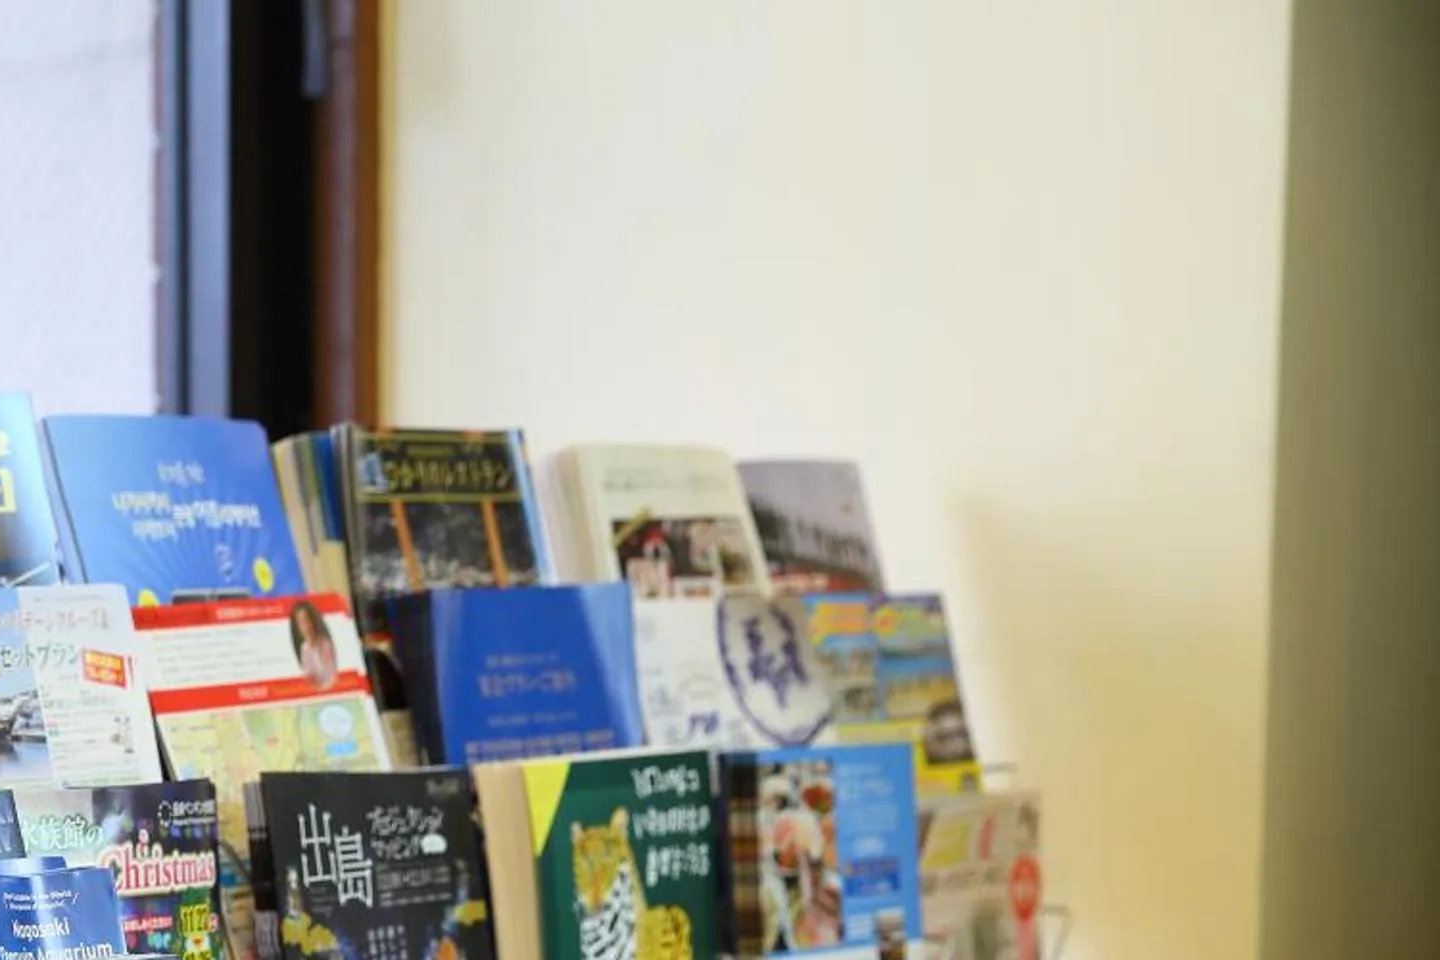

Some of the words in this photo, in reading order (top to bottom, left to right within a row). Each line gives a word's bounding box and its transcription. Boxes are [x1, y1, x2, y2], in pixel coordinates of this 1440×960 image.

[100, 843, 216, 893] Christmas
[298, 803, 373, 907] 出島
[12, 918, 71, 942] Nagasaki
